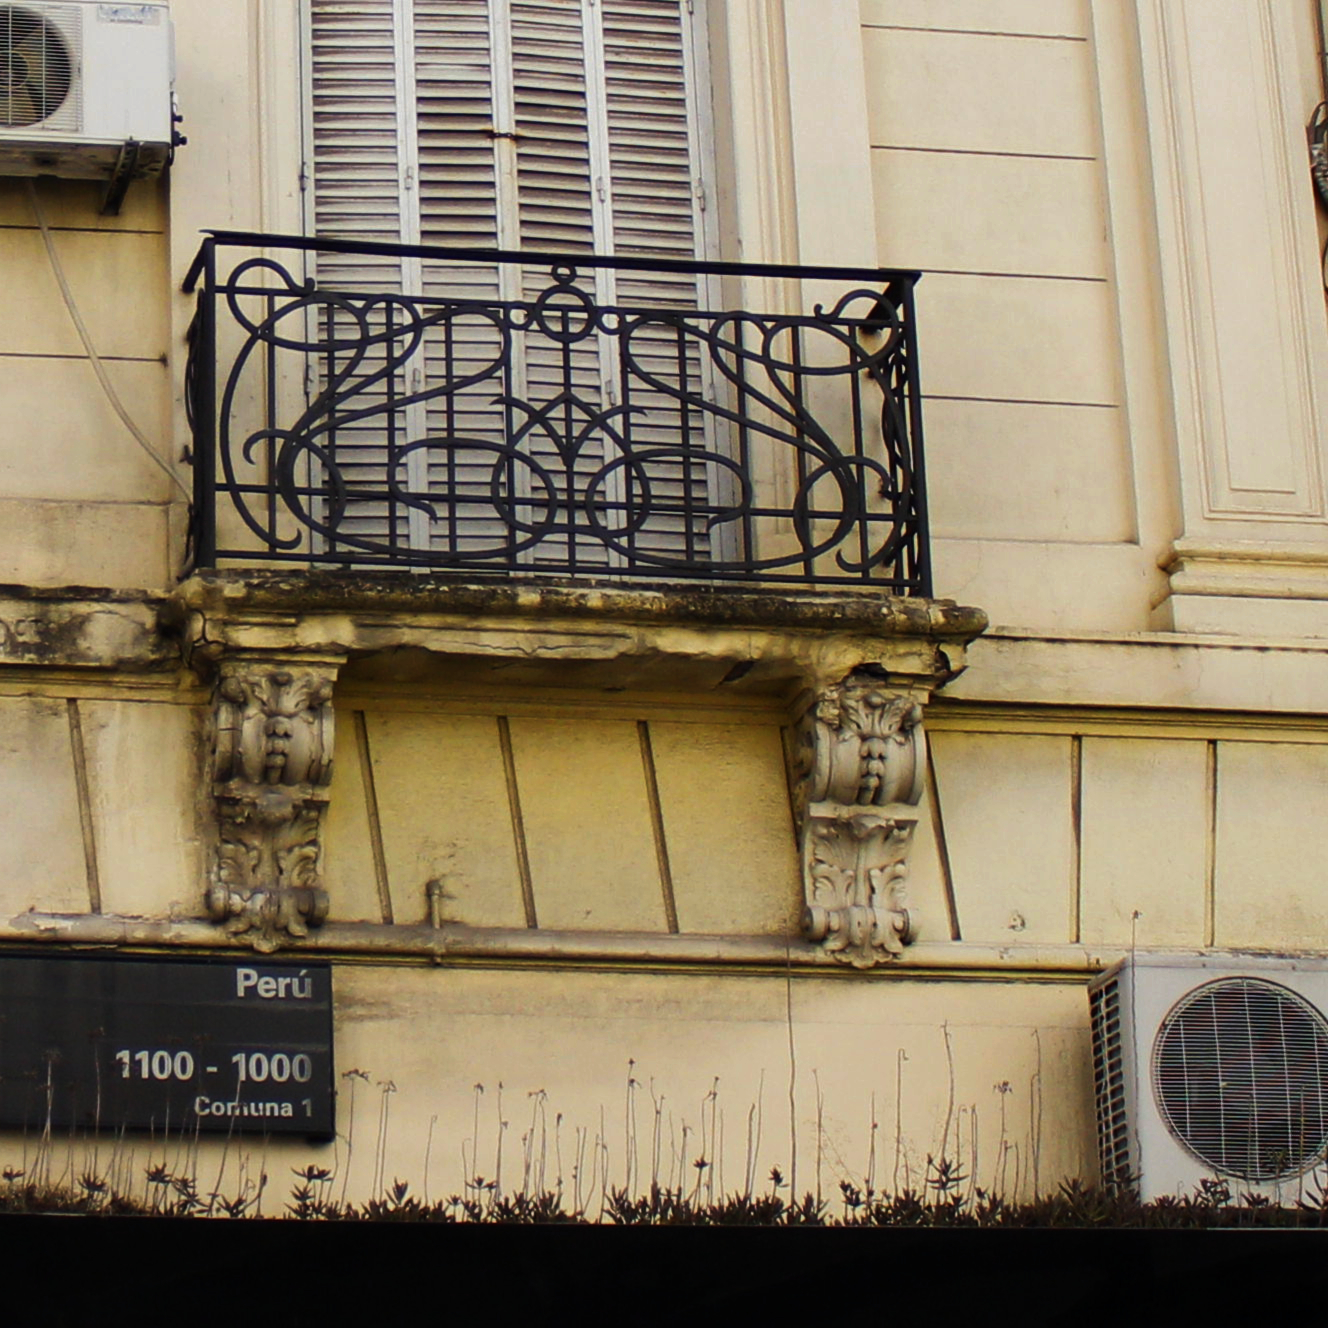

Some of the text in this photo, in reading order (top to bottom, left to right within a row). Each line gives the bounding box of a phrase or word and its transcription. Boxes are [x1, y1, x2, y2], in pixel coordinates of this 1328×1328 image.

[236, 968, 312, 998] Perú
[116, 1049, 195, 1081] 1100
[232, 1053, 313, 1083] 1000
[194, 1095, 313, 1117] Comuna 1
